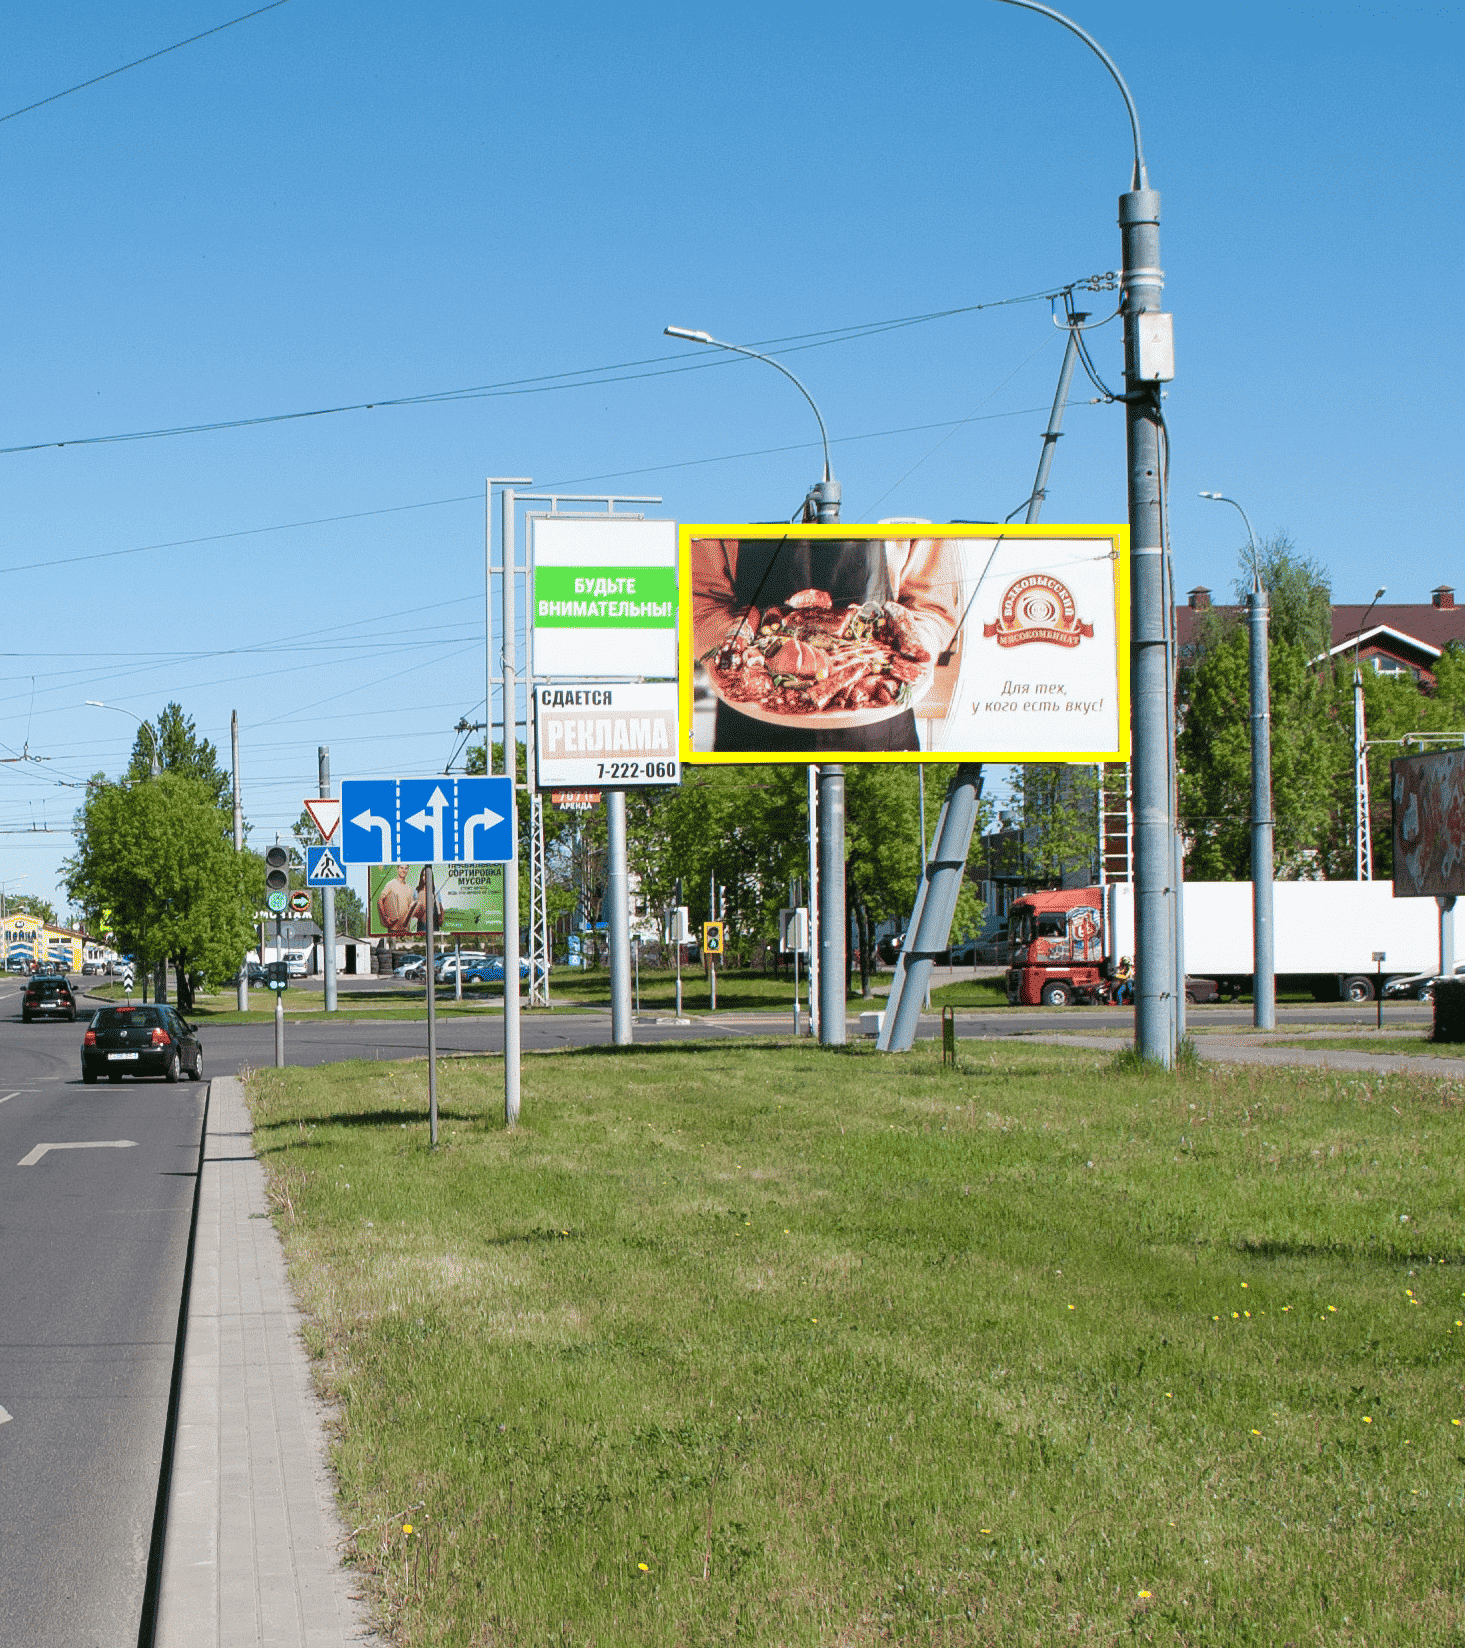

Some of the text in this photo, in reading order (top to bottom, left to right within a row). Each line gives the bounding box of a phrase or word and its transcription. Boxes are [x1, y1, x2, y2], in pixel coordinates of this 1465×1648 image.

[575, 578, 636, 597] БУДЬТЕ
[1003, 577, 1074, 616] ВОЛКОВЫССКИЙ
[538, 600, 673, 617] ВНИМАТЕЛЬНЫ!
[1001, 680, 1067, 696] Для тех,
[541, 690, 612, 708] СДАЕТСЯ
[971, 698, 1104, 716] у кого есть вкус!
[548, 719, 671, 752] РЕКЛАМА
[597, 762, 676, 779] 7-222-060
[559, 802, 593, 810] АРЕНДА
[448, 869, 502, 877] СОРТИРОВКА
[458, 877, 491, 885] МУСОРА
